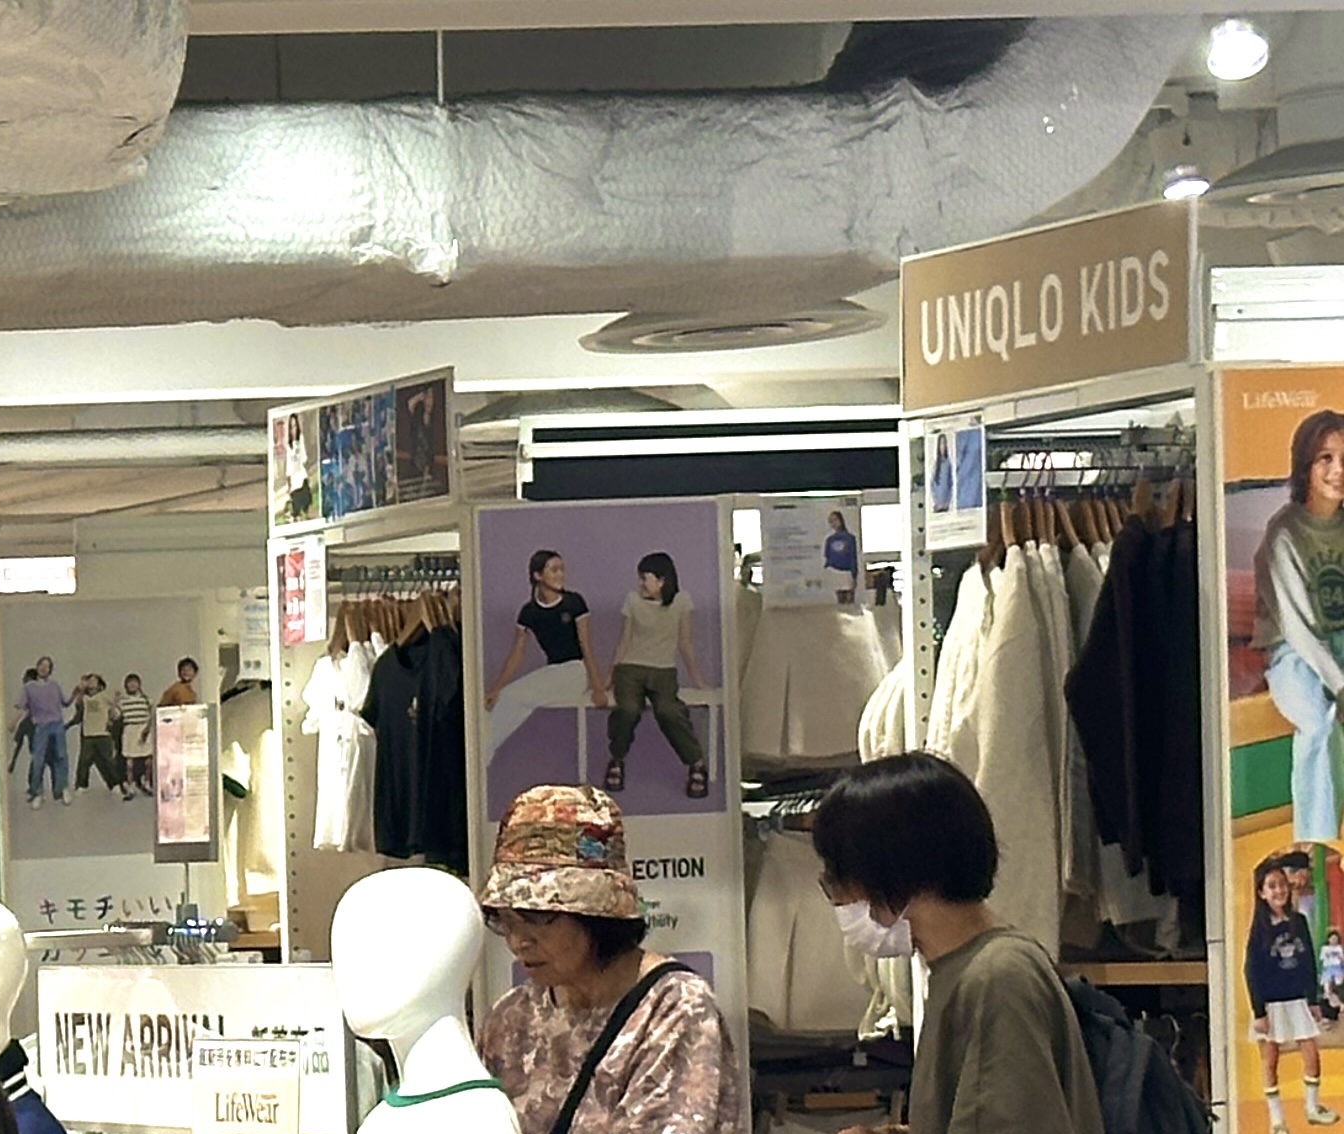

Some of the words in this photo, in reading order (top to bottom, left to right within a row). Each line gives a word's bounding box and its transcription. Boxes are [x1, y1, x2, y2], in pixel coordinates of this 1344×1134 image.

[920, 273, 1063, 366] UNIQLO
[1079, 249, 1170, 336] KIDS
[1242, 391, 1317, 410] LifeWear
[54, 1011, 111, 1075] NEW
[215, 1092, 280, 1125] LifeWear
